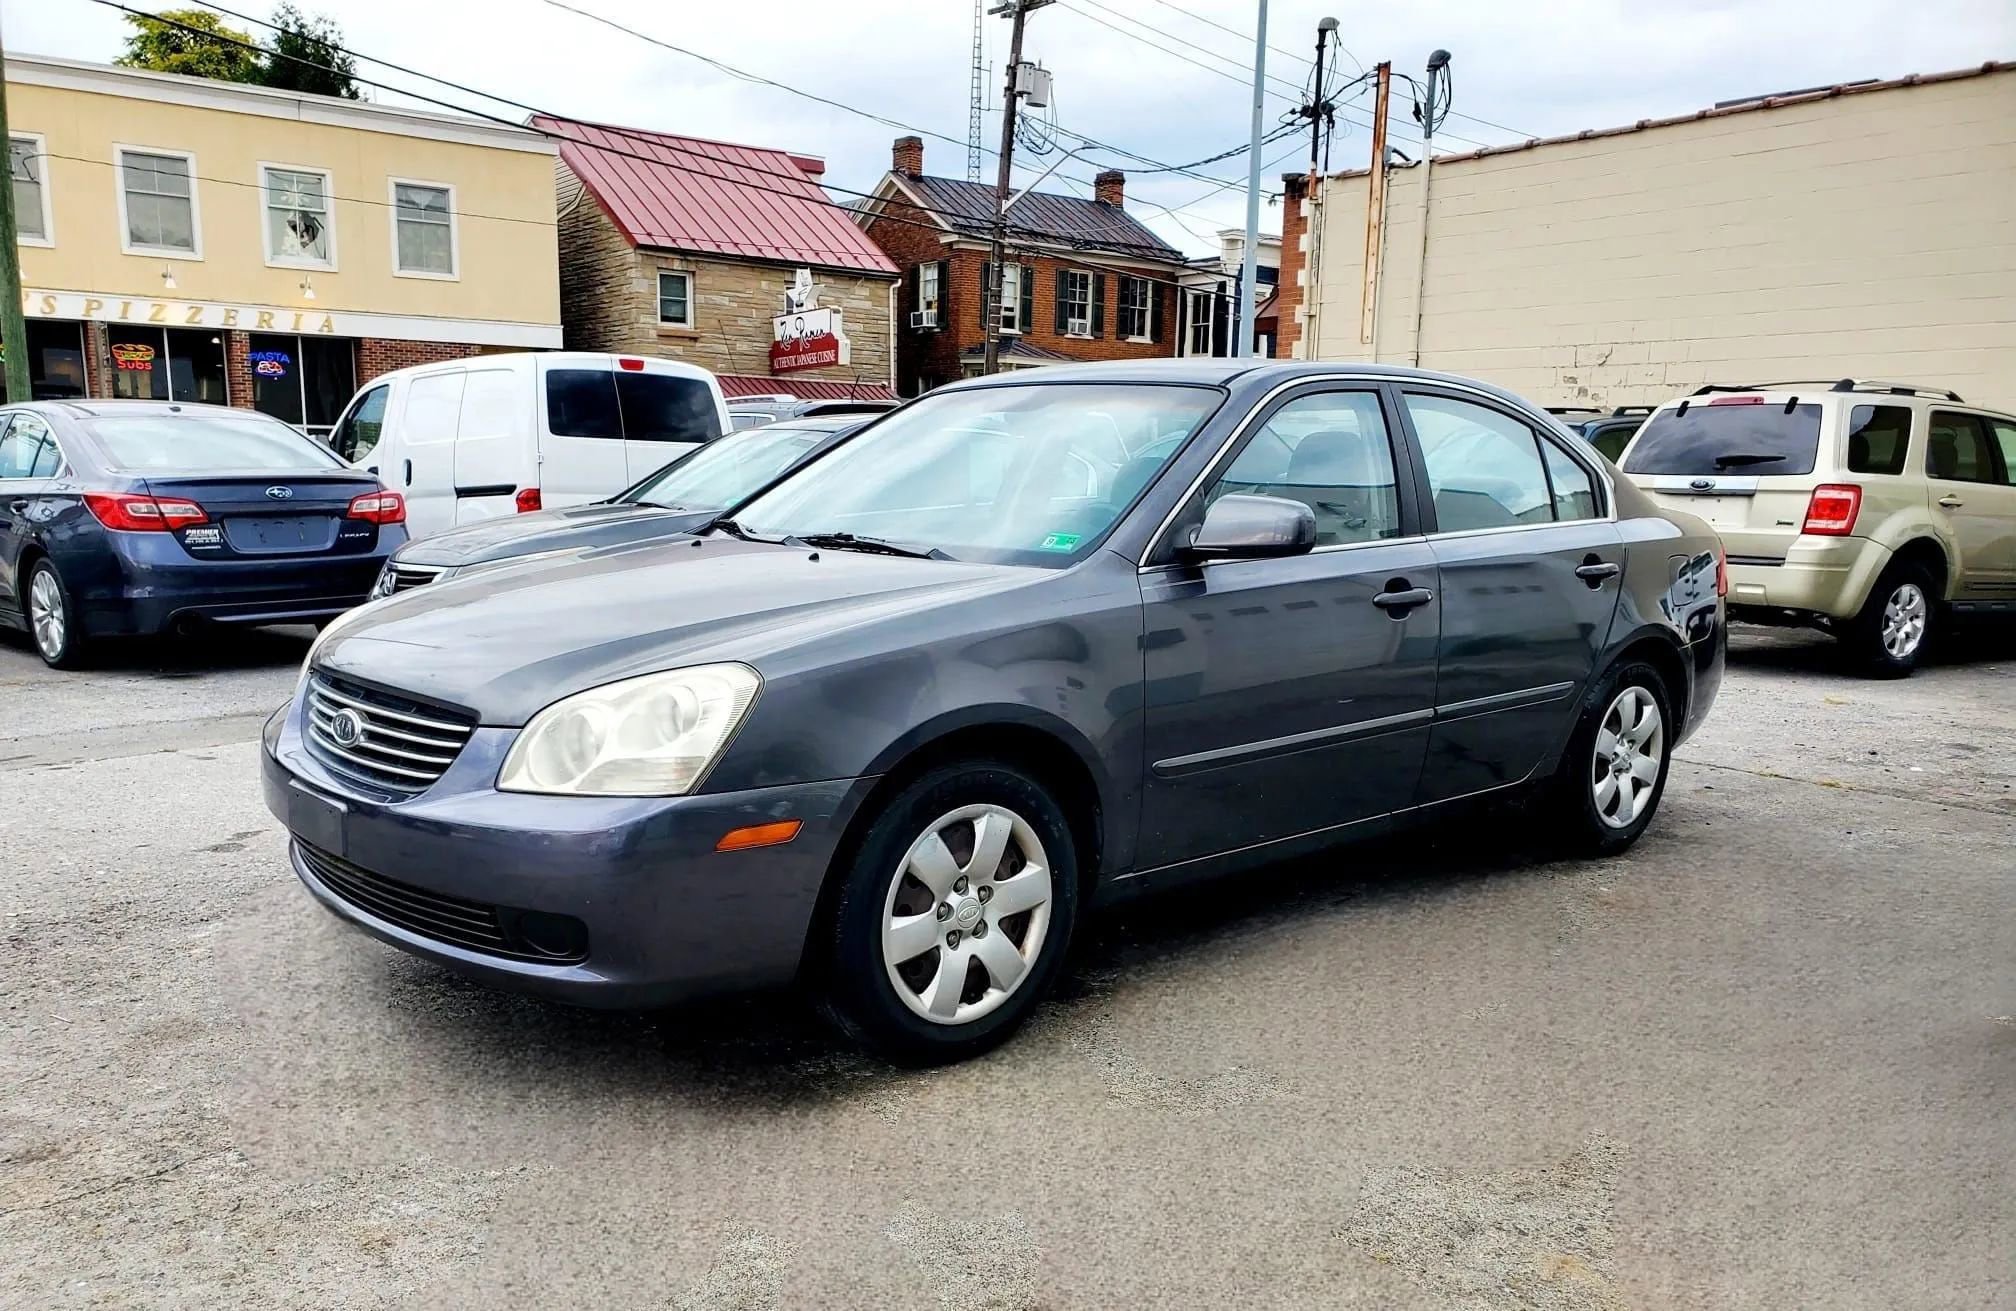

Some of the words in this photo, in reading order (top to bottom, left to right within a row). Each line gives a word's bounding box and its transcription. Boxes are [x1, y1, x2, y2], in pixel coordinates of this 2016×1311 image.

[81, 298, 334, 333] PIZZERIA
[795, 316, 826, 352] Ramen
[117, 360, 153, 371] Subs
[248, 351, 291, 364] PASTA
[774, 355, 796, 369] AUTHENTIC
[797, 352, 817, 366] JAPANESE
[817, 349, 836, 363] CUISINE
